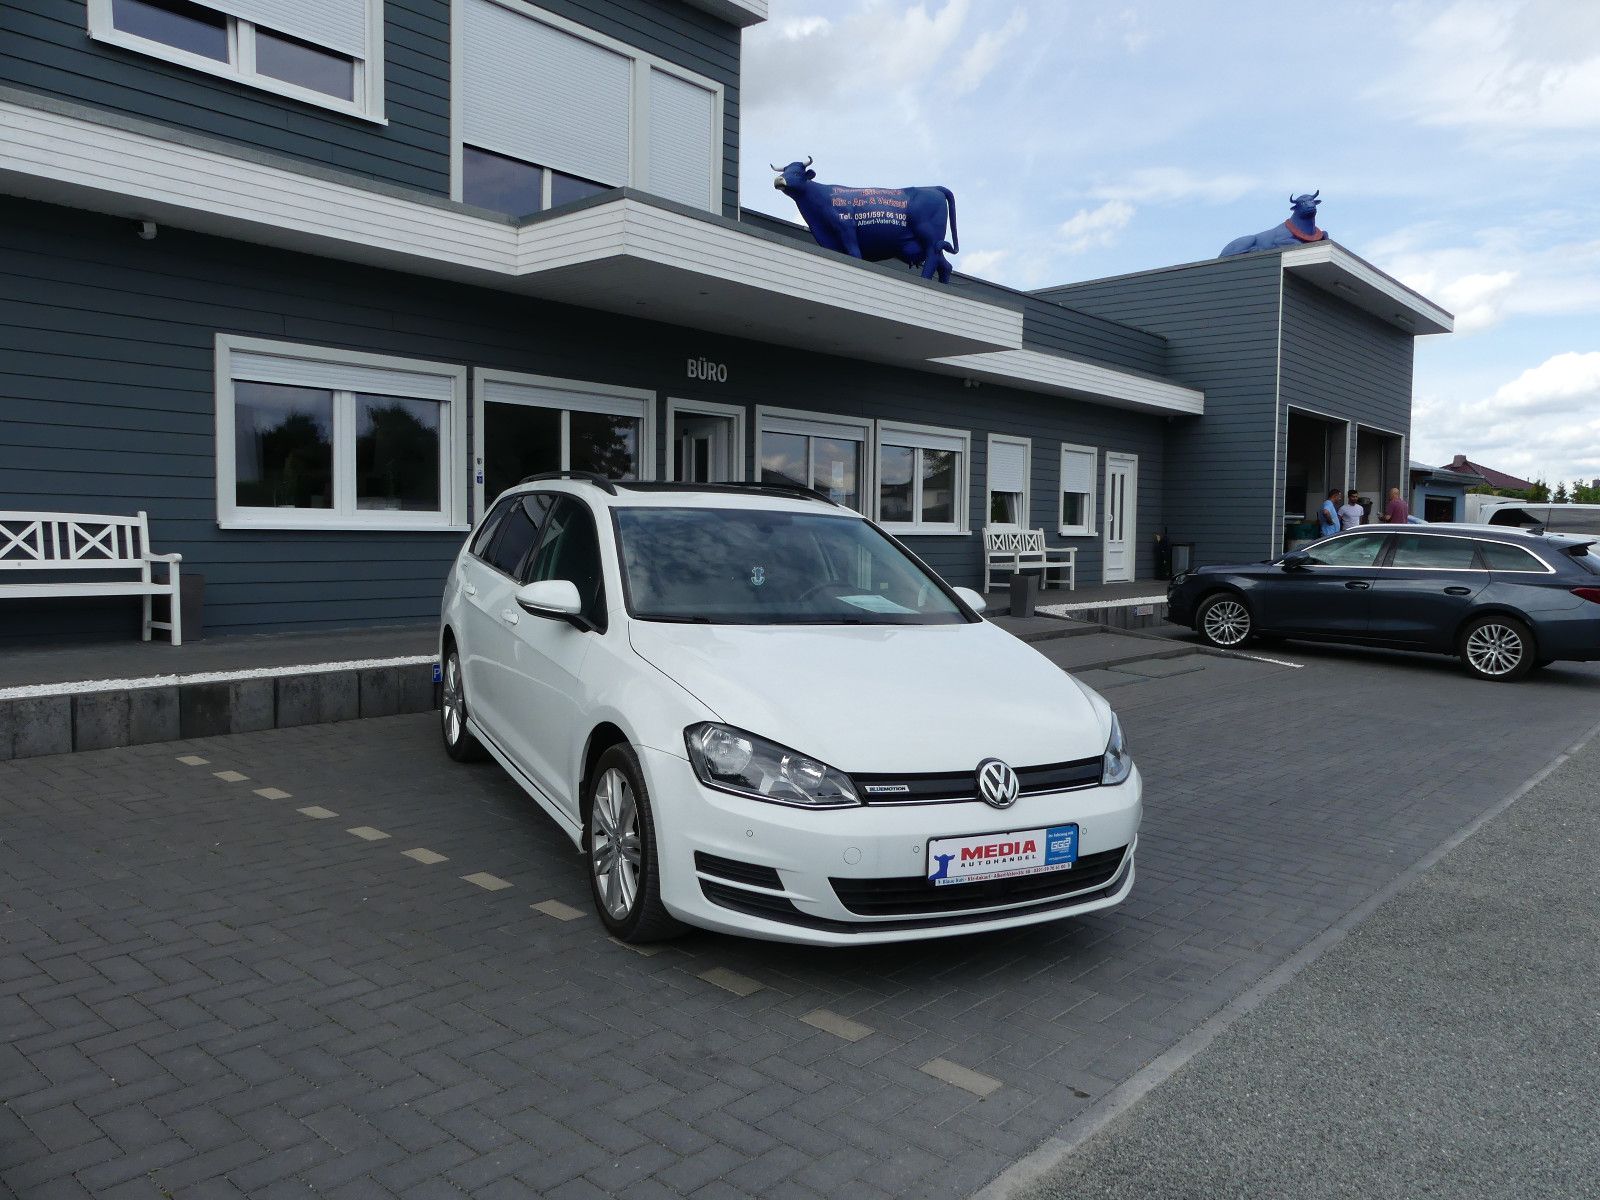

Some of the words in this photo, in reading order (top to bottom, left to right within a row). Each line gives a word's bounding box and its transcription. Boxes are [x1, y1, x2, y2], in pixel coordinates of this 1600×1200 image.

[854, 211, 884, 220] 0391/597
[895, 213, 907, 221] 100
[687, 357, 728, 383] BÜRO
[433, 668, 441, 679] P
[960, 839, 1037, 861] MEDIA
[960, 854, 1037, 868] AUTOHANDEL
